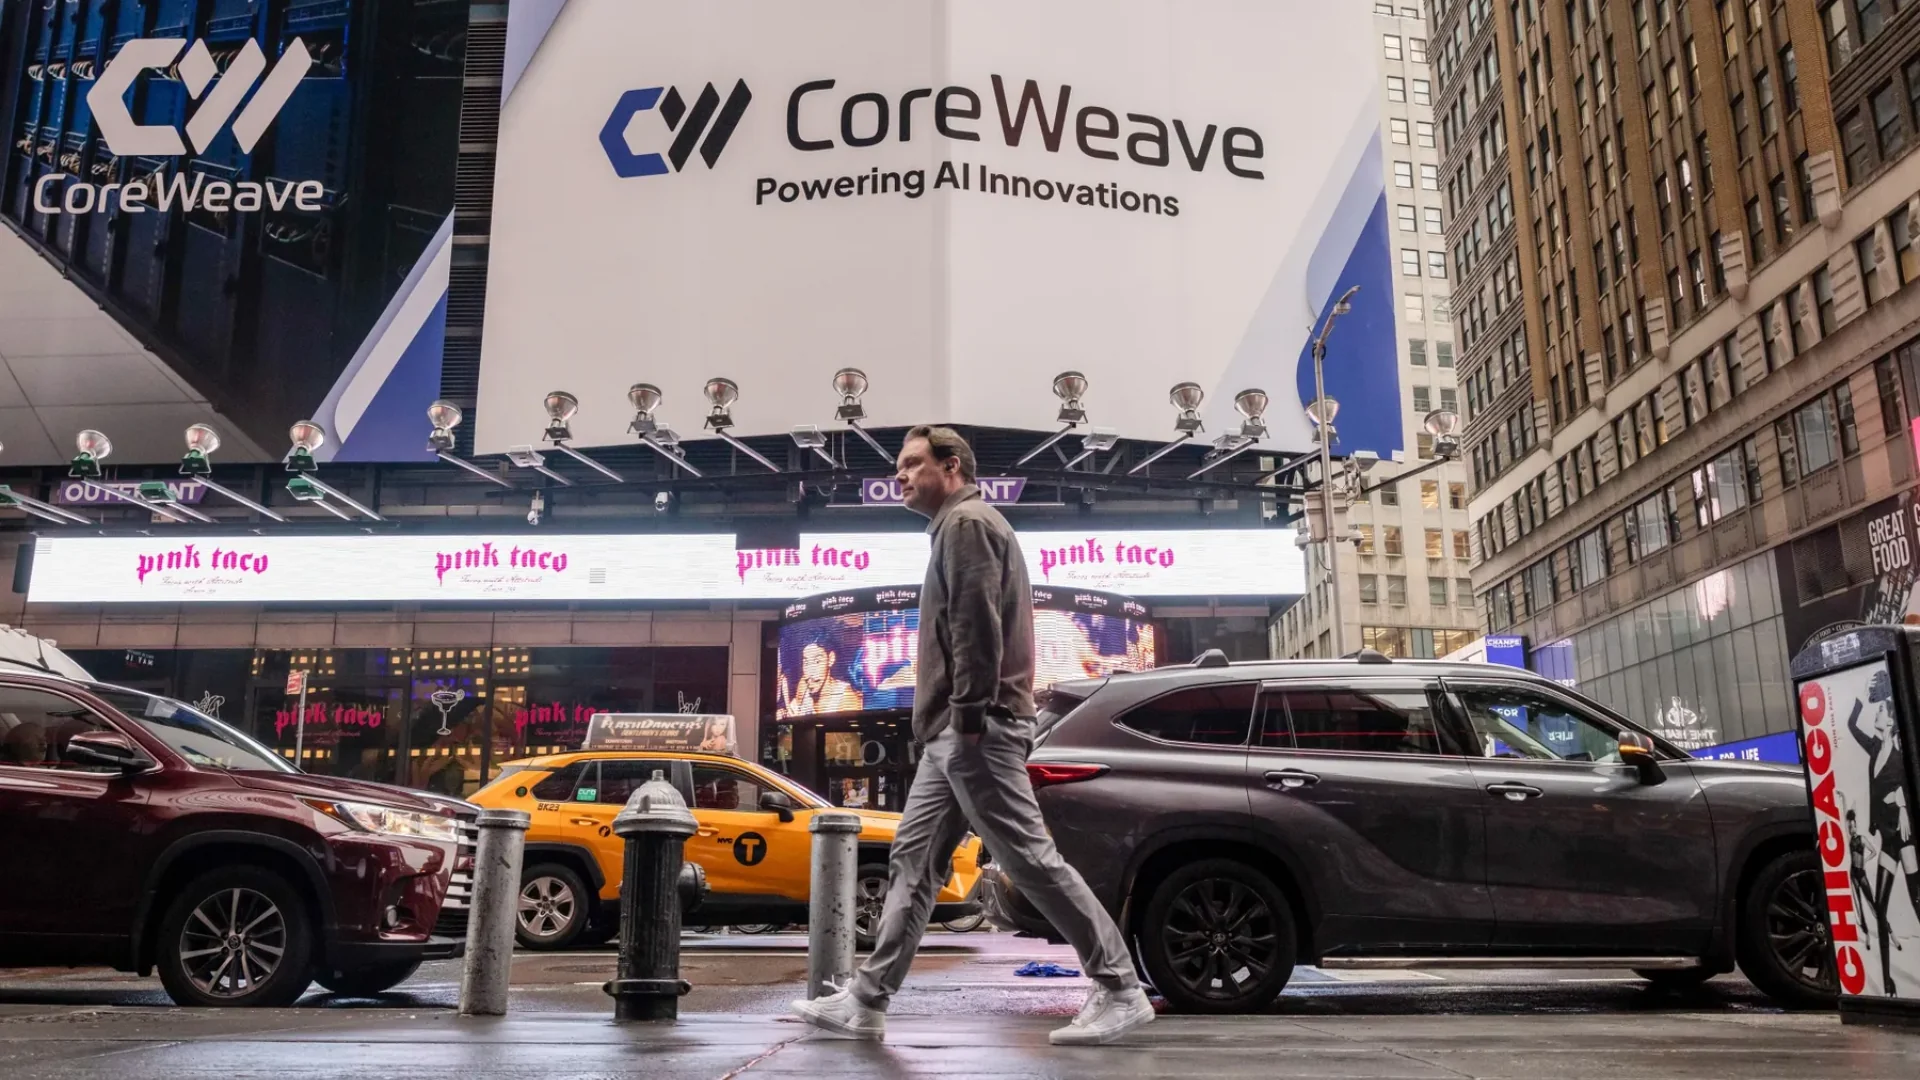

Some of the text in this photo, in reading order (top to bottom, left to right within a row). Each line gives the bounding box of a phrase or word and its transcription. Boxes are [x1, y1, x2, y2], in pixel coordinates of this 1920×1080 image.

[786, 73, 1265, 181] CoreWeave
[33, 171, 324, 214] CoreWeave
[755, 160, 1180, 217] Powering AI Innovations
[1868, 509, 1905, 547] GREAT
[136, 543, 268, 587] pink taco
[434, 541, 567, 586] pink taco
[811, 543, 869, 570] taco
[1039, 537, 1174, 583] pink taco
[1871, 536, 1911, 576] FOOD
[514, 701, 567, 739] pink
[740, 837, 761, 863] T
[1799, 681, 1866, 996] CHICAGO
